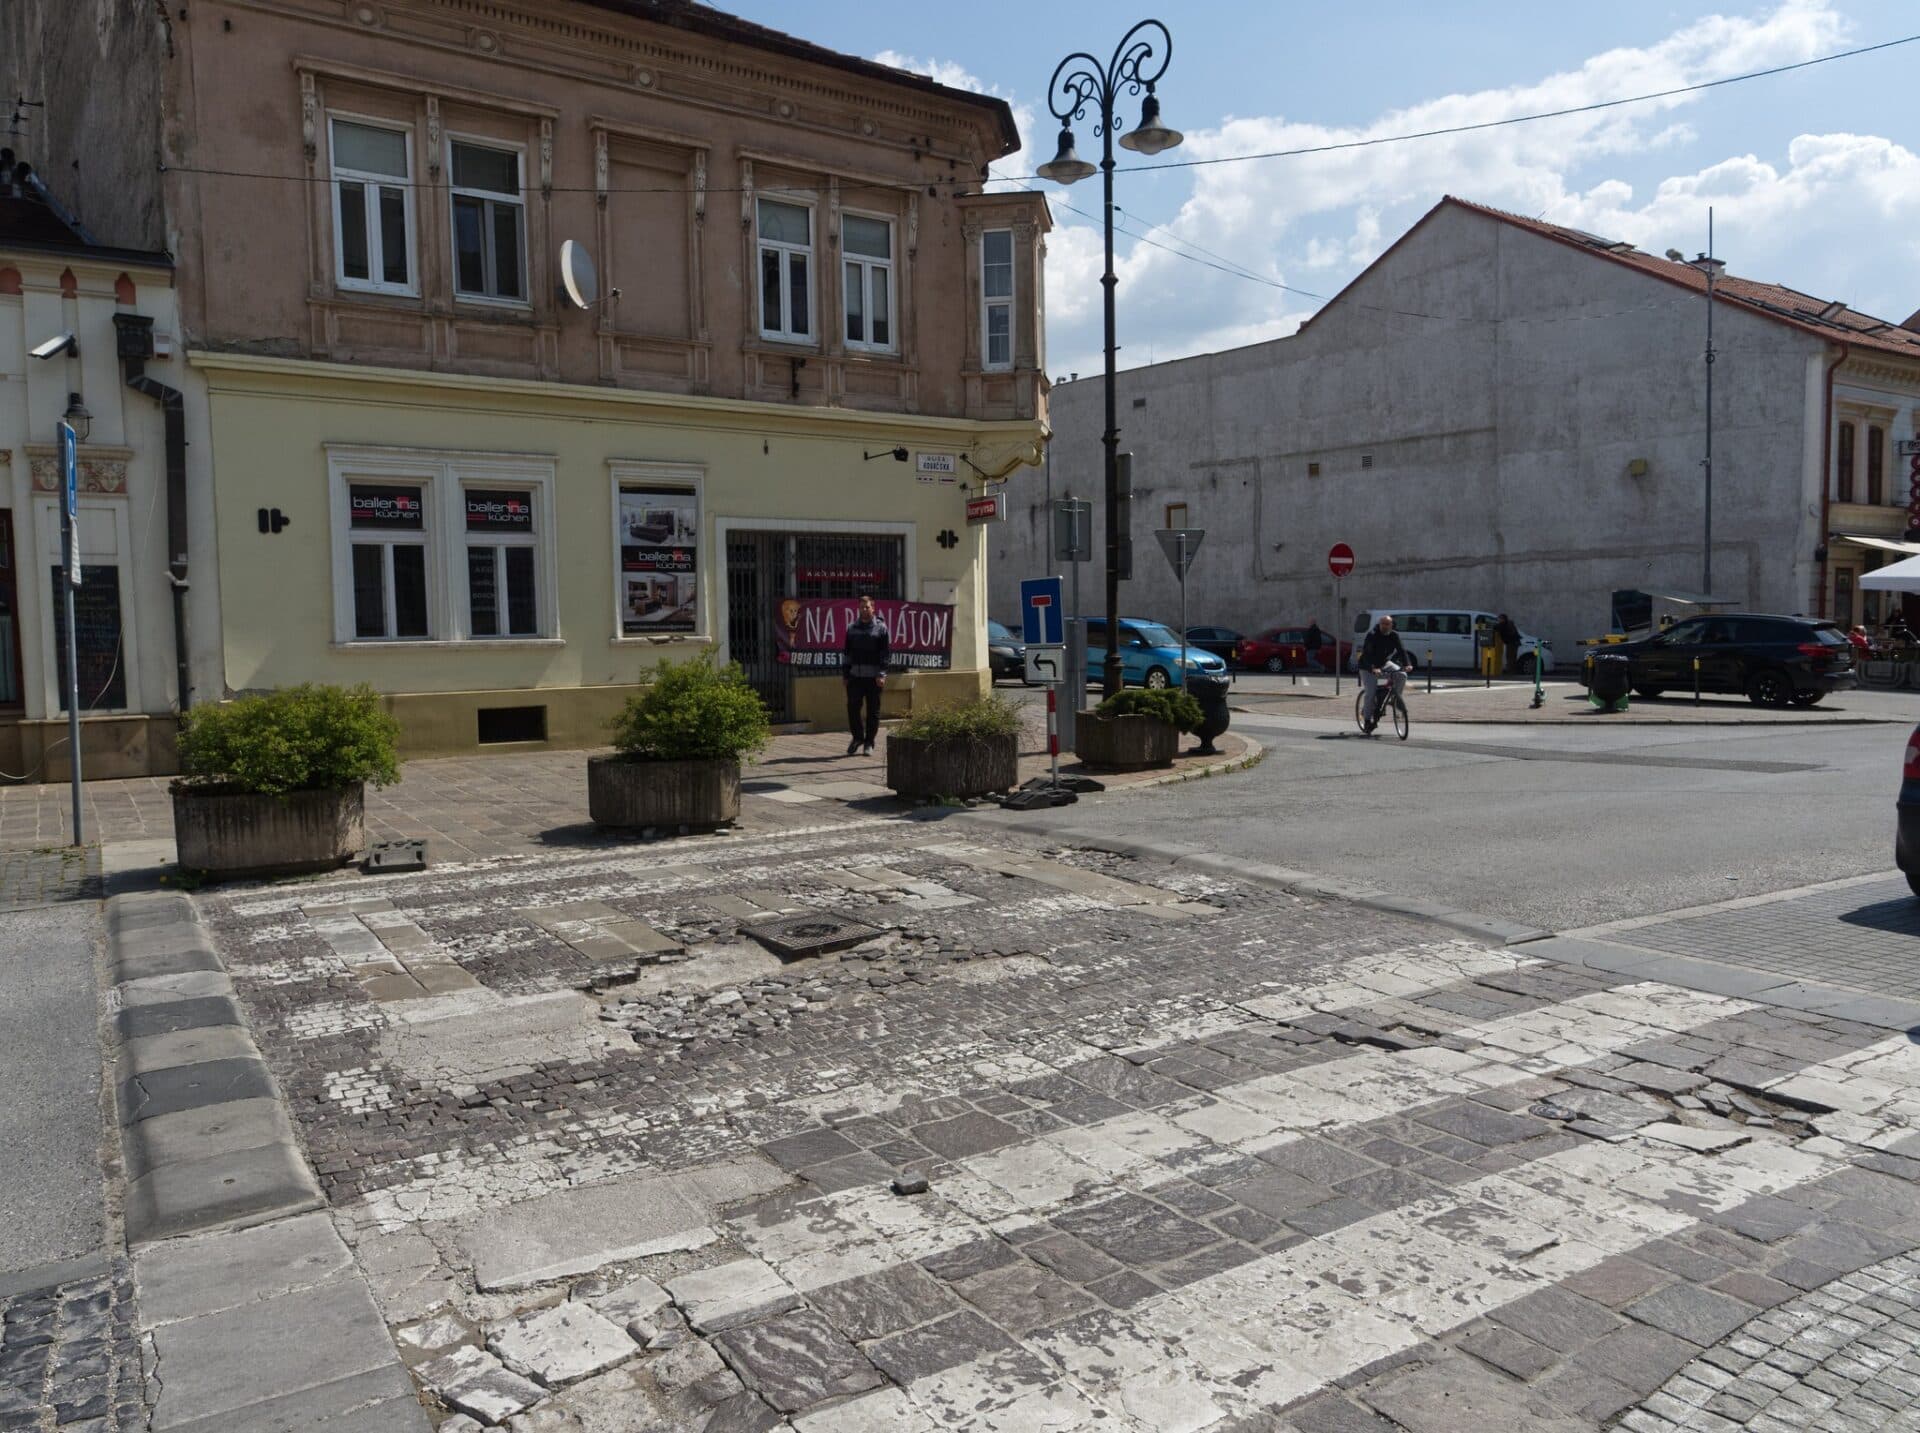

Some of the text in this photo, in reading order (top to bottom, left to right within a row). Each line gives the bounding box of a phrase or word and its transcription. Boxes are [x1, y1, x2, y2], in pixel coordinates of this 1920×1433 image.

[352, 496, 419, 510] ballerina
[467, 501, 529, 513] ballerina
[375, 508, 420, 518] küchen
[487, 512, 529, 522] küchen
[638, 551, 691, 561] ballerina
[655, 561, 692, 569] küchen
[805, 603, 948, 648] NA PNÁJOM
